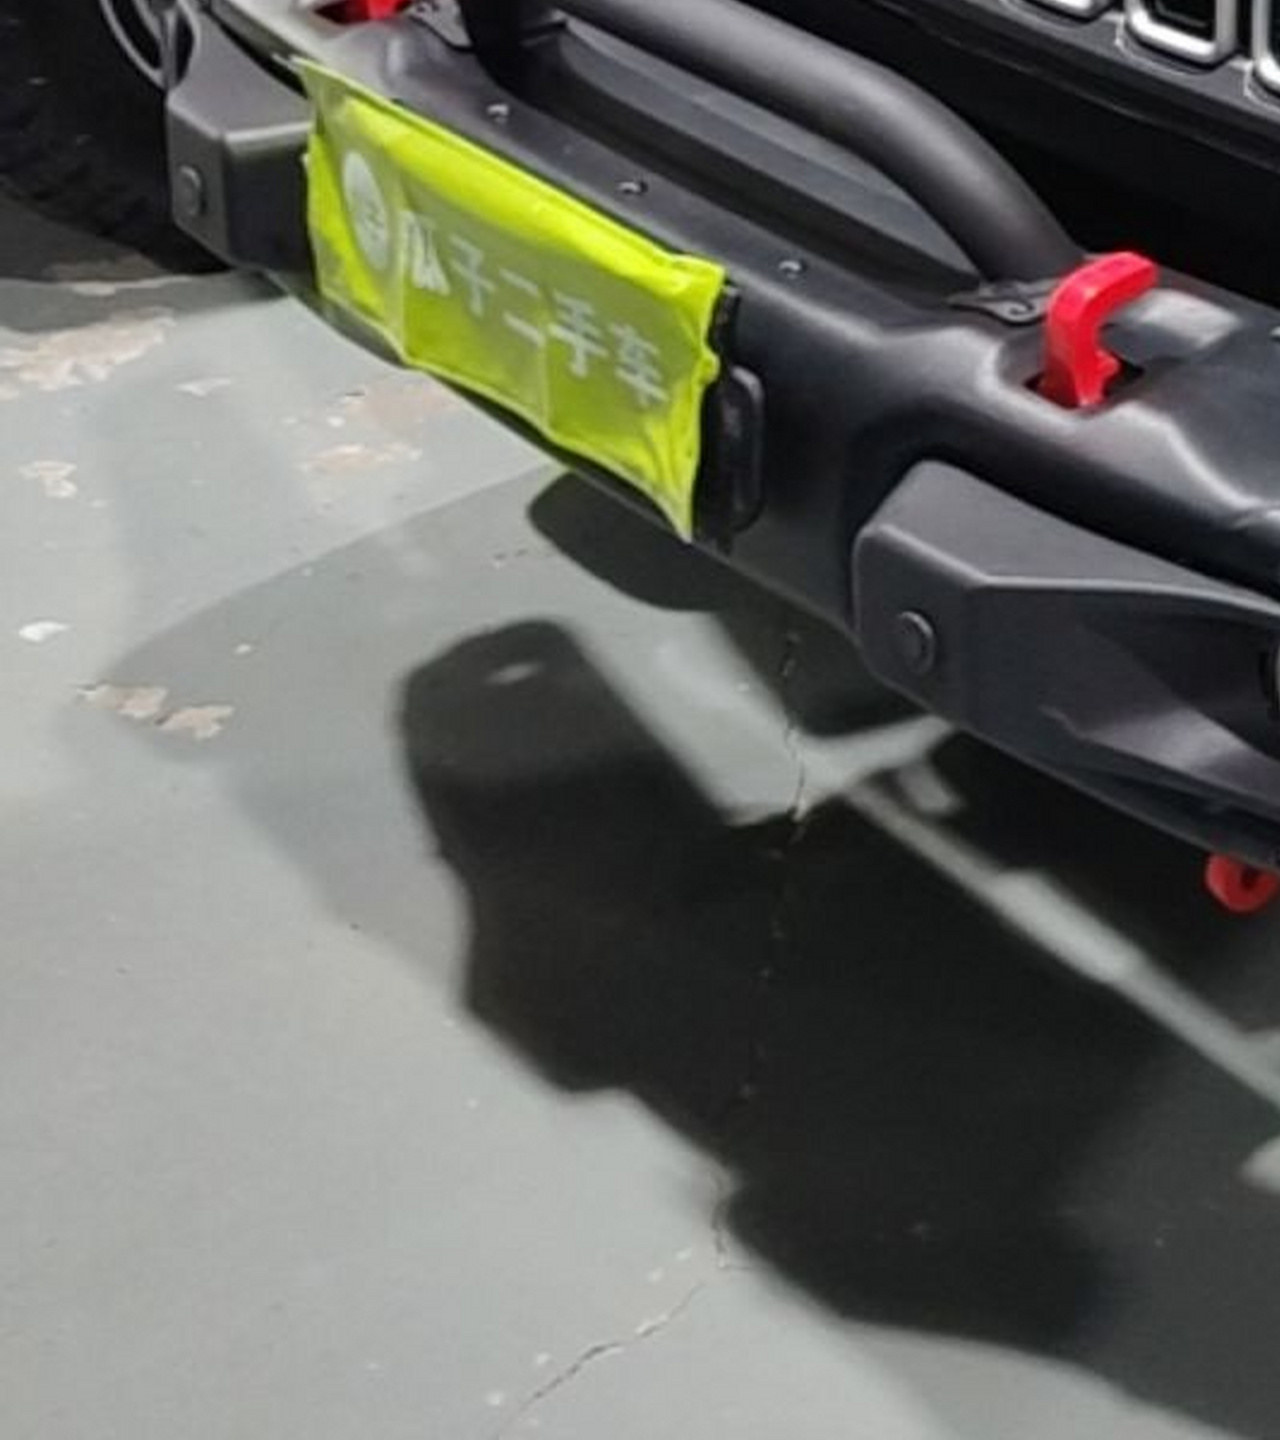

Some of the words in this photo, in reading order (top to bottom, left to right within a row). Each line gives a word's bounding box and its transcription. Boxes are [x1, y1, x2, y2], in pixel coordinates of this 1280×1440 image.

[400, 208, 669, 405] 瓜子二手车
